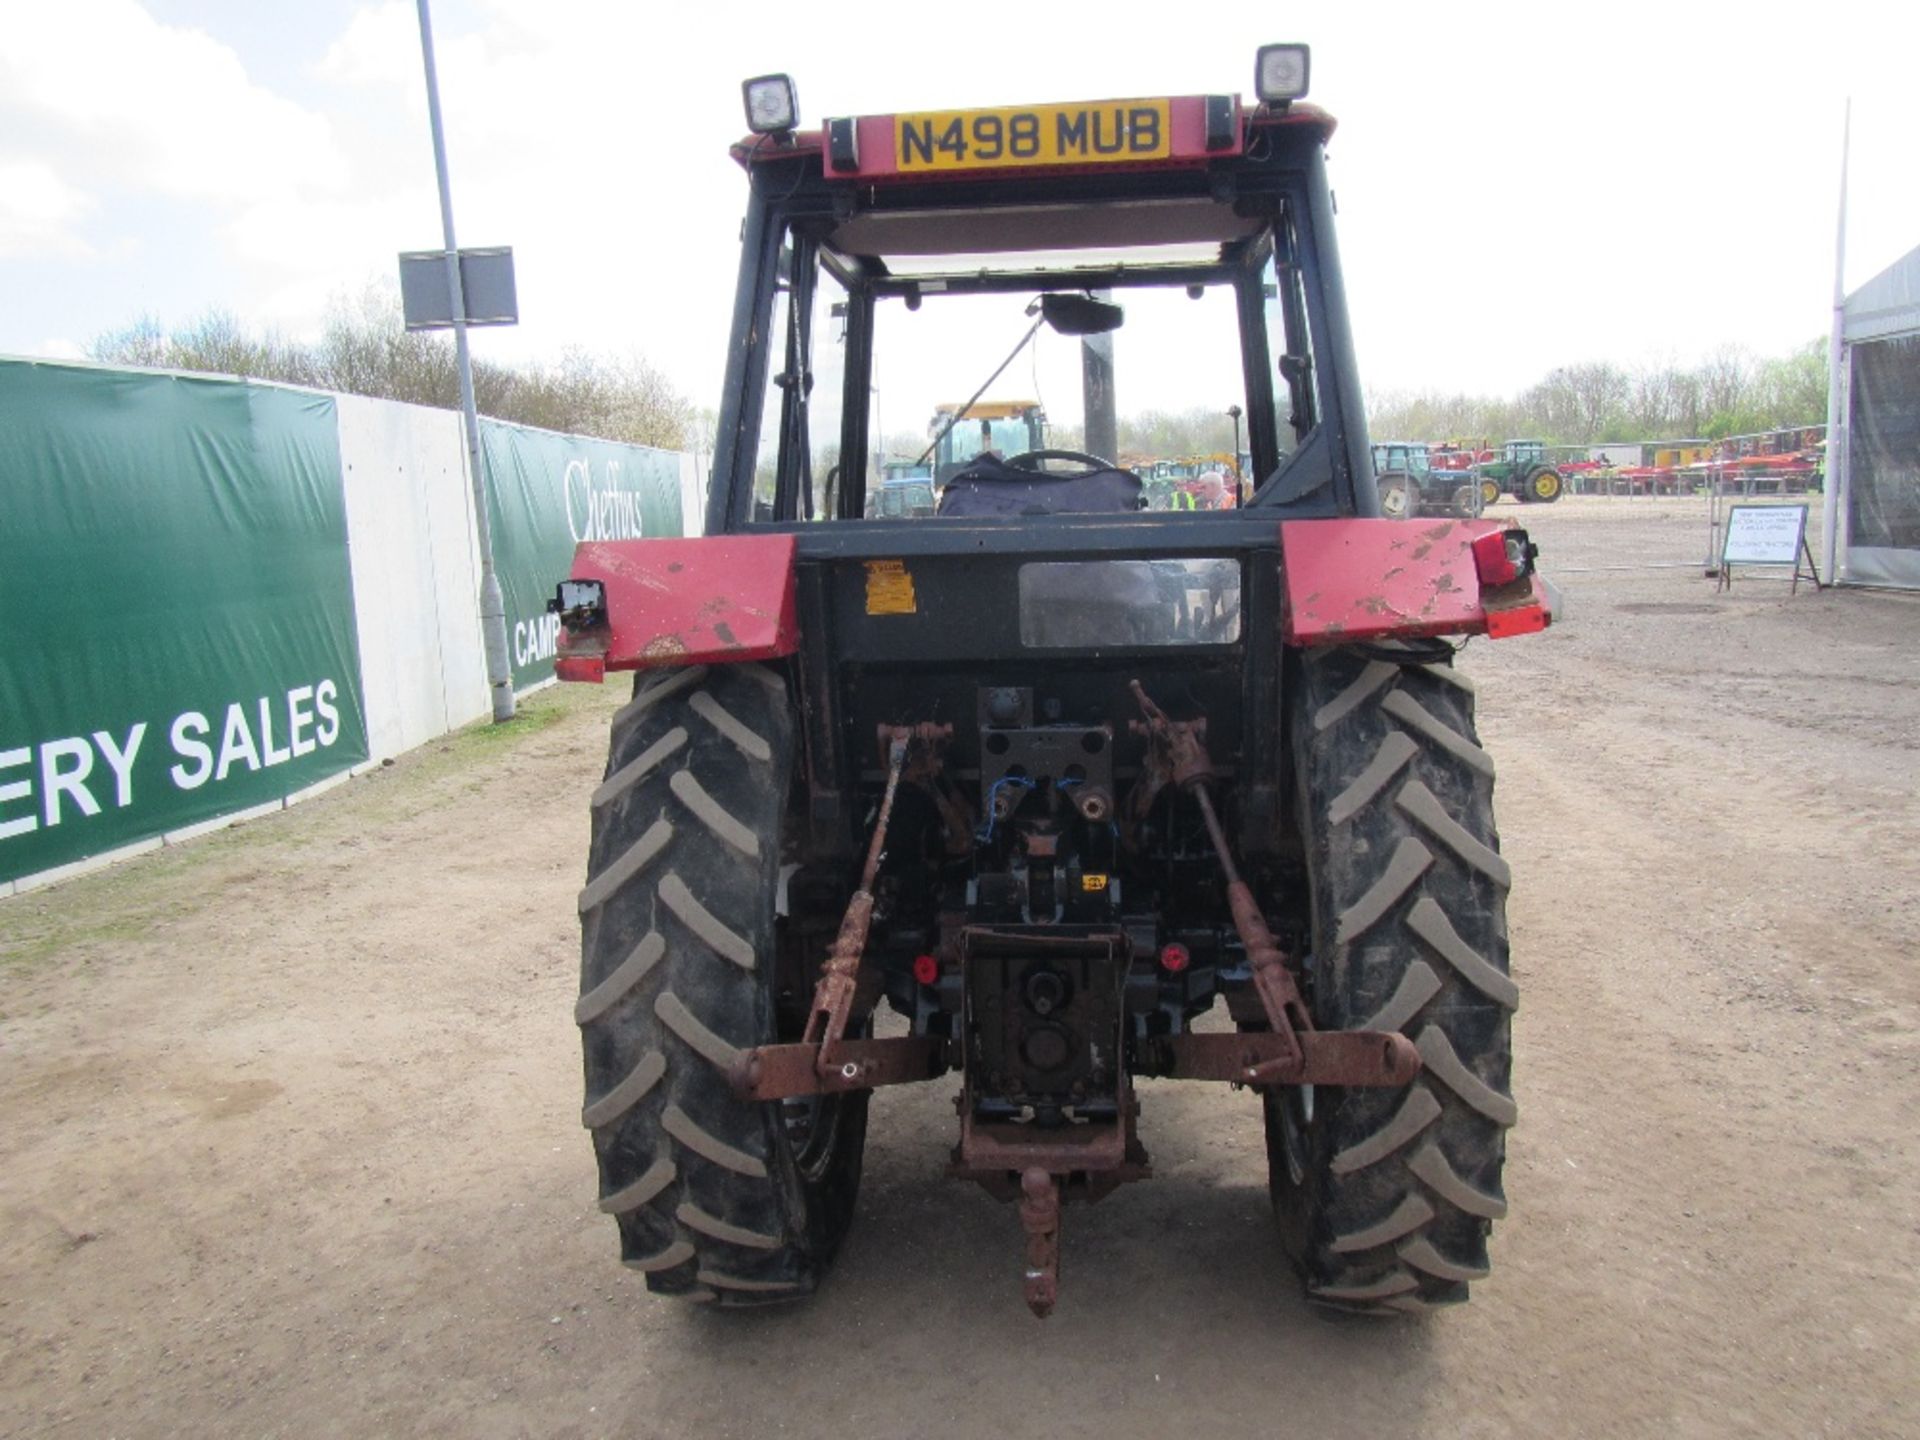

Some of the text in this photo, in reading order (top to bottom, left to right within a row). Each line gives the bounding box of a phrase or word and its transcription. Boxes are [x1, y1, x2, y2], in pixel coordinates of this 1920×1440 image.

[902, 107, 1161, 164] N498 MUB
[170, 678, 340, 790] SALES
